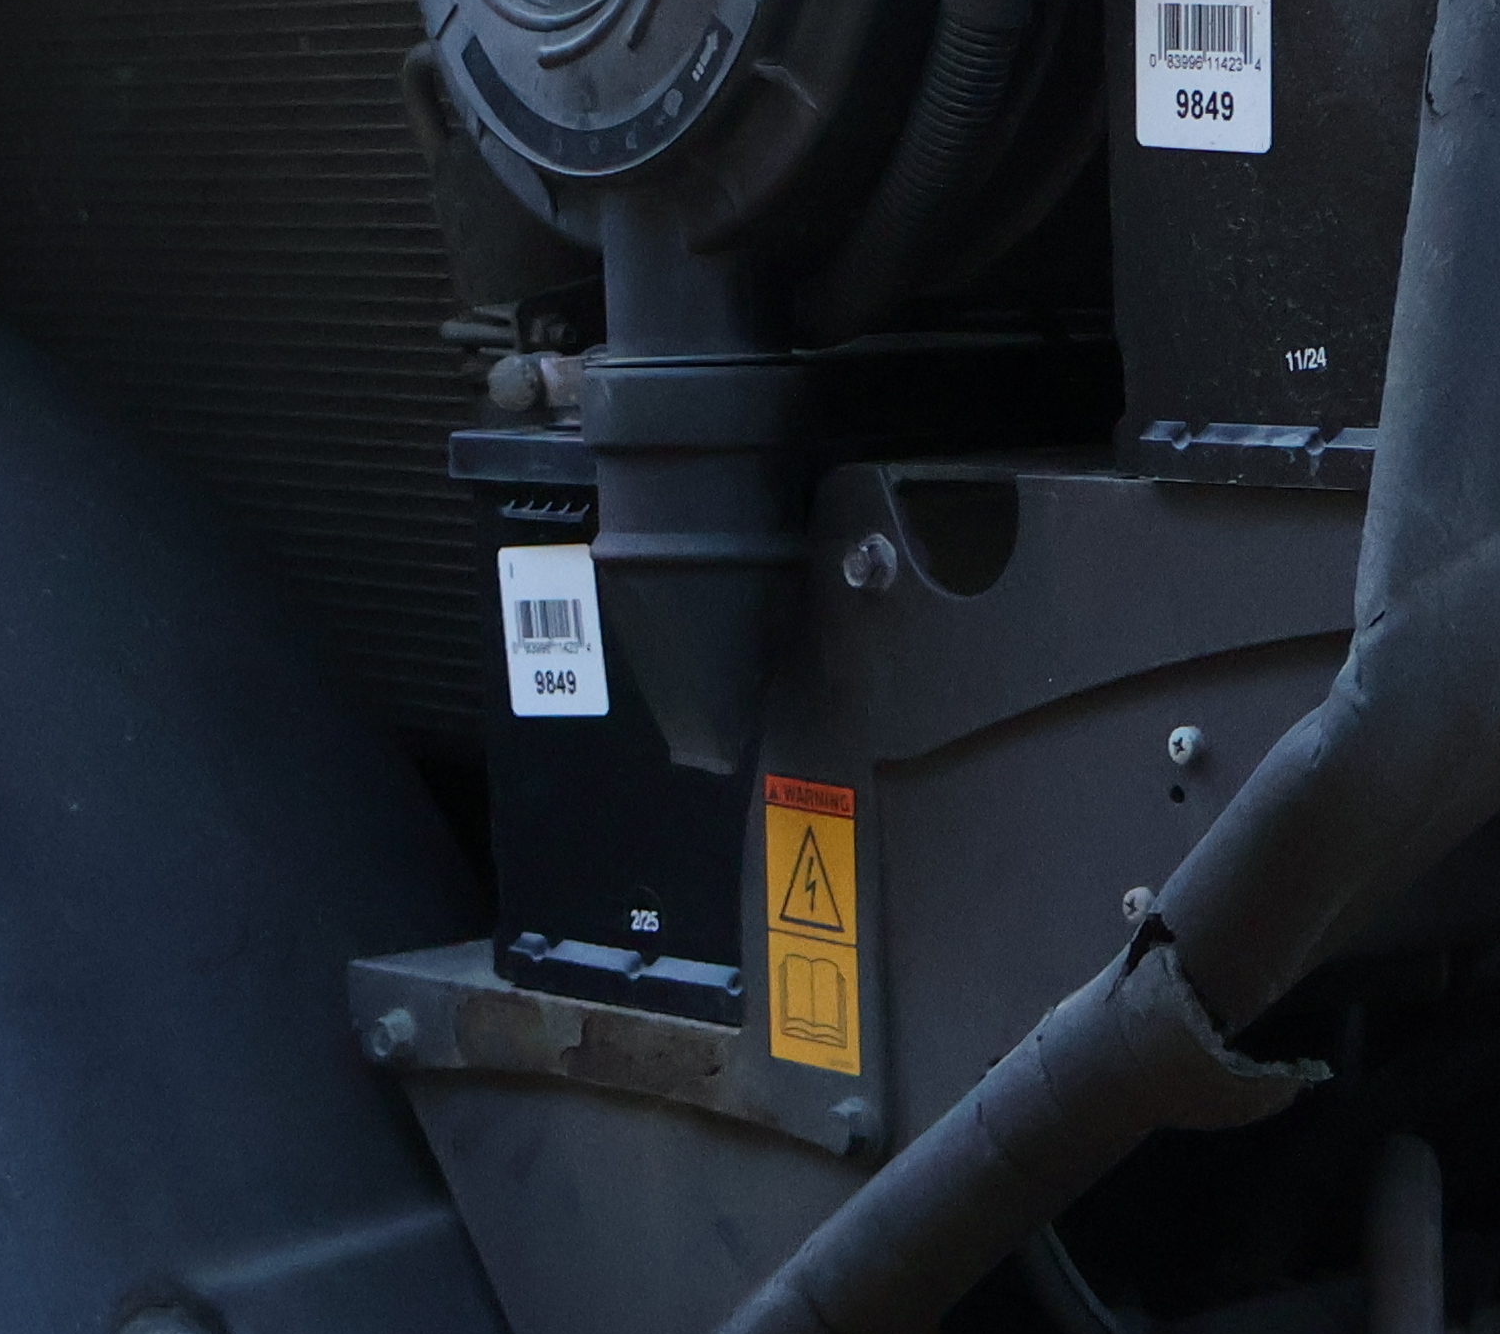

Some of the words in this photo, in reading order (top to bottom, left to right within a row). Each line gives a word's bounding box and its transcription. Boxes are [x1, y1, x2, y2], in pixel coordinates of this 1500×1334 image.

[1149, 53, 1157, 68] 0
[1166, 54, 1204, 70] 83996
[1207, 55, 1244, 72] 11423
[1254, 57, 1262, 72] 4
[1175, 88, 1235, 122] 9849
[1284, 346, 1328, 372] 11/24
[534, 669, 577, 696] 9849
[783, 784, 851, 813] WARNING
